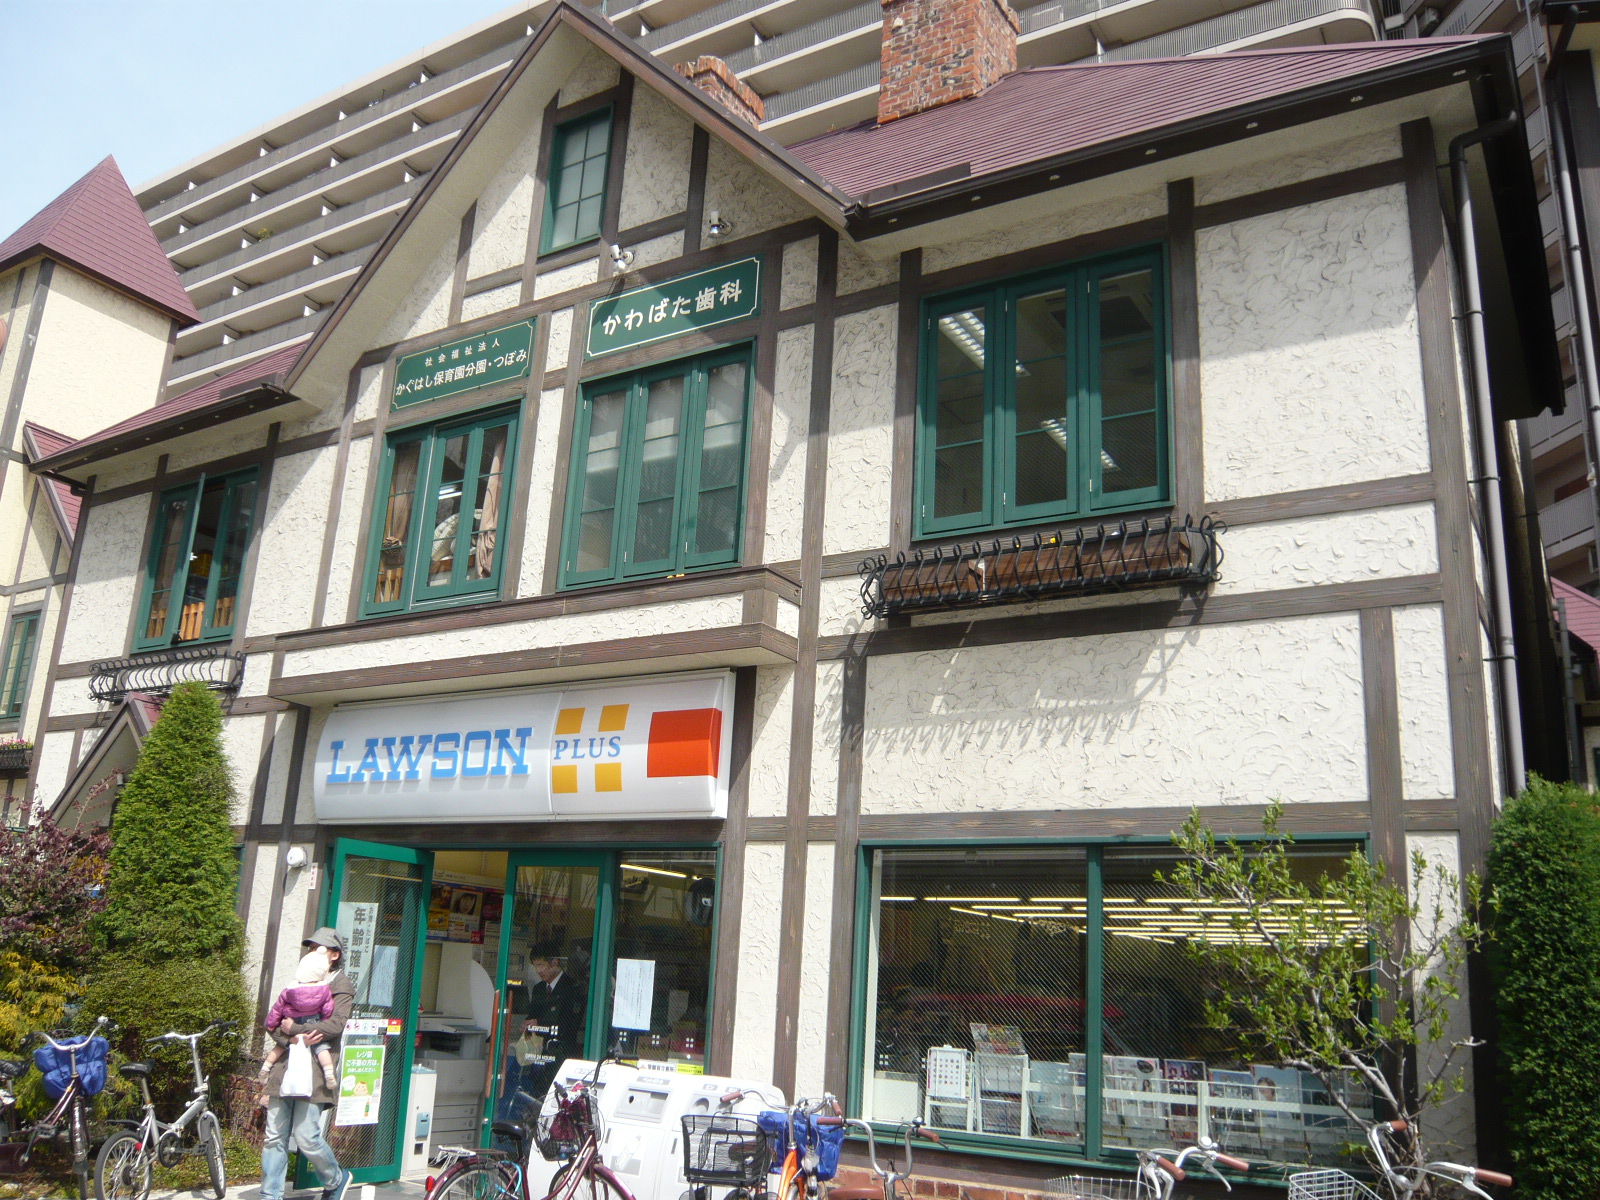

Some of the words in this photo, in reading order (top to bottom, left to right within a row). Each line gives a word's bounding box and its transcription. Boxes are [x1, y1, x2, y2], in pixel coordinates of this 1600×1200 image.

[602, 278, 743, 336] かわばた歯科
[394, 348, 528, 396] かぐはし保育園分園・つぼみ
[424, 337, 500, 367] 社会福祉法人
[326, 726, 535, 784] LAWSON
[553, 735, 621, 760] PLUS
[527, 1025, 550, 1033] LAWSON
